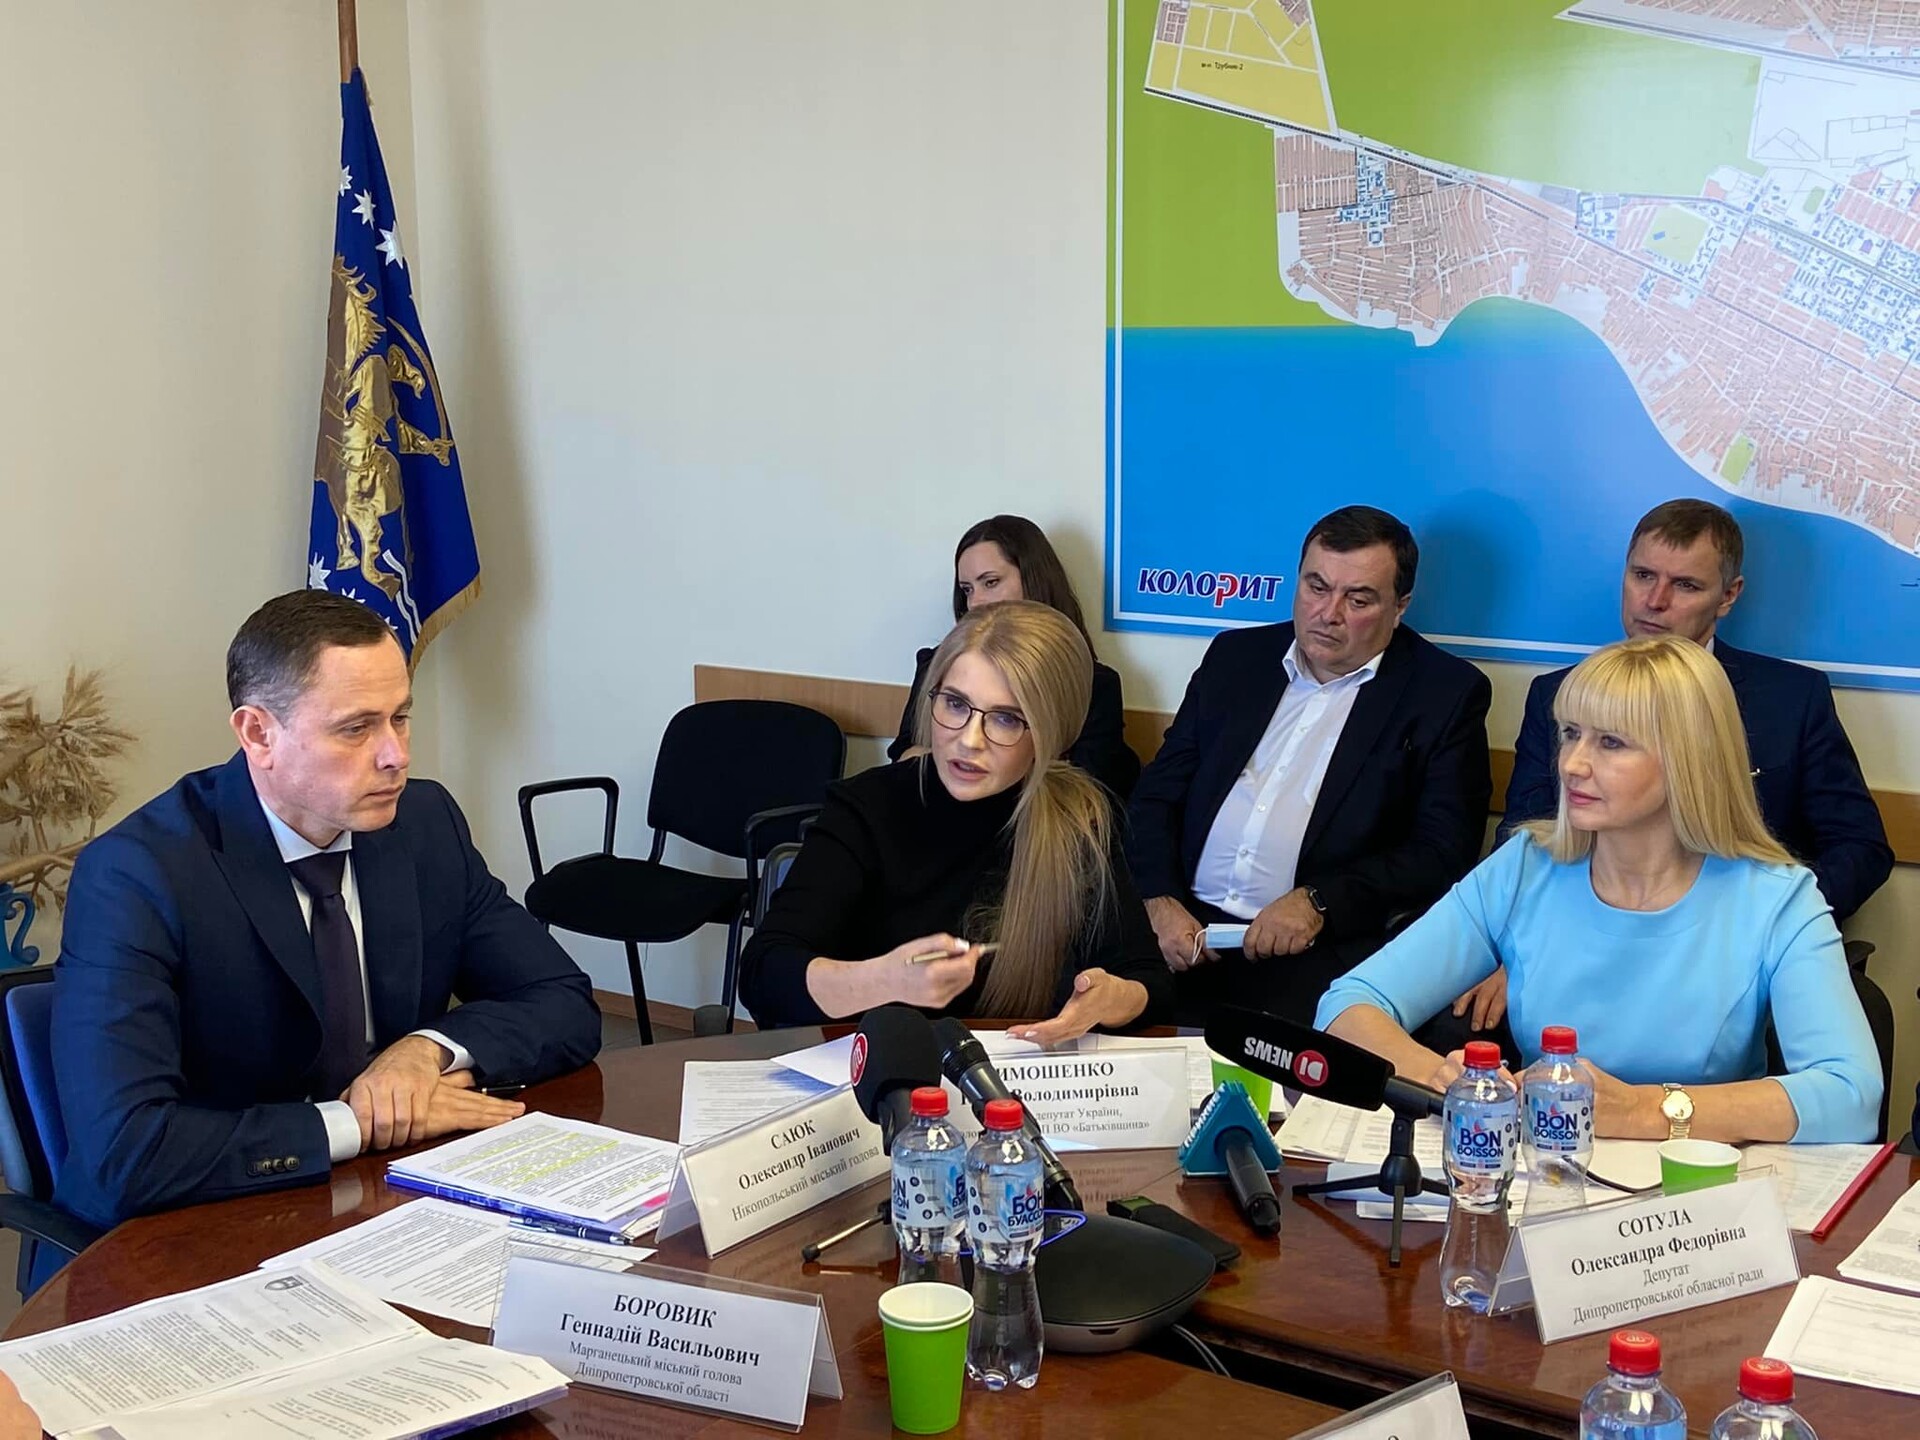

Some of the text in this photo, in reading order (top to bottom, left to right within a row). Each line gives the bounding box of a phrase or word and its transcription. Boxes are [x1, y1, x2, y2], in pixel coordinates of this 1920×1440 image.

[1138, 568, 1282, 607] КОЛОРИТ
[1244, 1036, 1294, 1070] NEWS
[996, 1061, 1114, 1081] ИМОШЕНКО
[1053, 1122, 1070, 1134] ВО
[1077, 1106, 1123, 1120] України,
[1536, 1110, 1578, 1131] BON
[771, 1119, 816, 1150] САЮК
[1460, 1128, 1502, 1148] BON
[1533, 1127, 1580, 1140] BOISSON
[739, 1127, 861, 1190] Олександр Іванович
[1457, 1145, 1504, 1158] BOISSON
[731, 1145, 880, 1222] Нікопольський міський голова
[1008, 1208, 1043, 1226] БУАССО
[1012, 1189, 1042, 1216] БОН
[1618, 1208, 1692, 1238] СОТУЛА
[1571, 1226, 1747, 1276] Олександра Федорівна
[1643, 1264, 1691, 1287] Депутат
[613, 1294, 717, 1329] БОРОВИК
[1573, 1268, 1764, 1325] Дніпропетровської обласної ради
[560, 1313, 760, 1367] Геннадій Васильович
[569, 1341, 742, 1385] Марганецький міський голова
[575, 1361, 730, 1403] Дніпропетровської області
